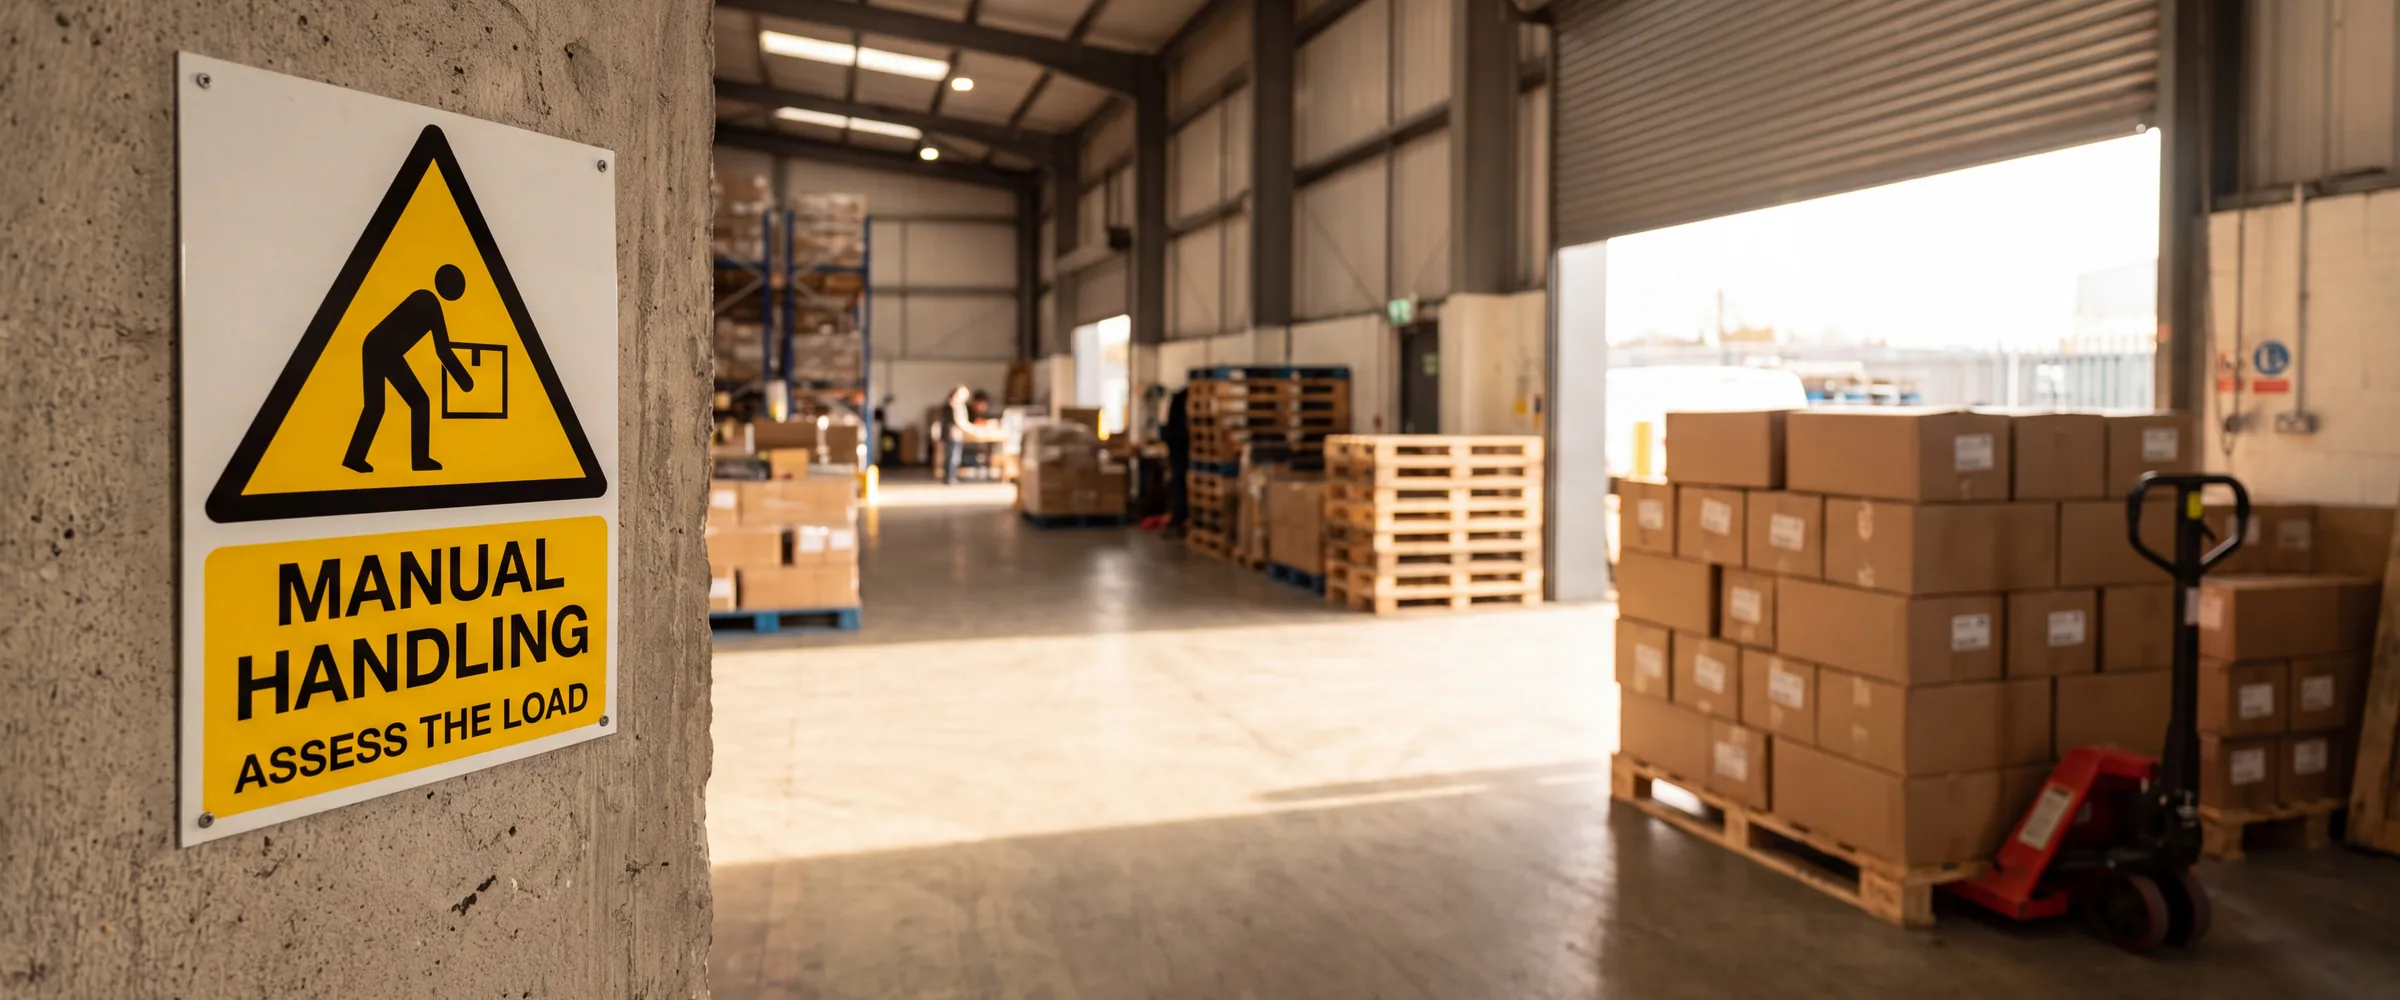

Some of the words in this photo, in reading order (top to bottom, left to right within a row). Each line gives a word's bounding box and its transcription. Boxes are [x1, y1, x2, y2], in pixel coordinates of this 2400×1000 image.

[278, 537, 565, 627] MANUAL
[237, 604, 588, 722] HANDLING
[234, 722, 408, 795] ASSESS
[419, 702, 492, 749] THE
[503, 682, 588, 730] LOAD
